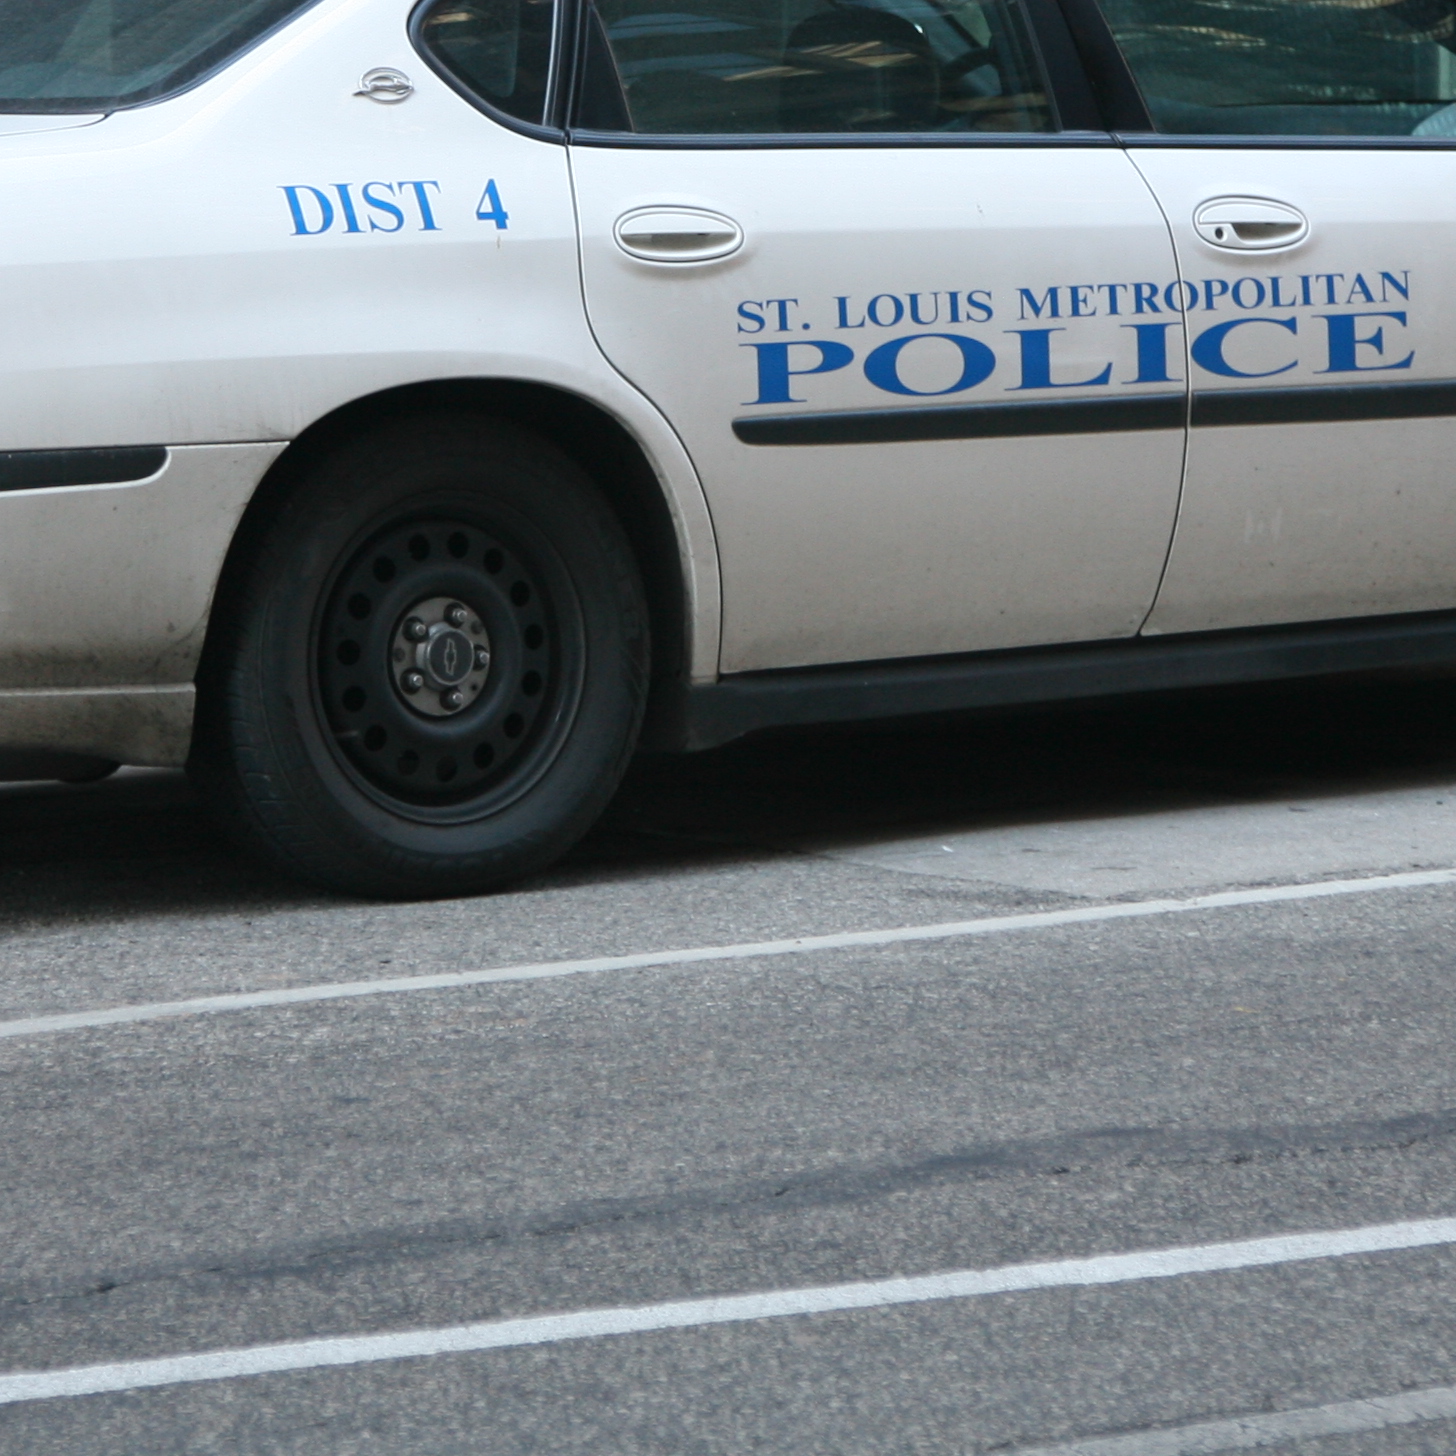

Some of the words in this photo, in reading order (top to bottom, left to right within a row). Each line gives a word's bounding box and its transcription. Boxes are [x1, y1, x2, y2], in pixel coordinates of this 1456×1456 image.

[276, 180, 443, 236] DIST
[475, 178, 509, 230] 4
[737, 299, 811, 334] ST.
[833, 290, 995, 329] LOUIS
[1016, 270, 1411, 321] METROPOLITAN
[738, 311, 1416, 406] POLICE
